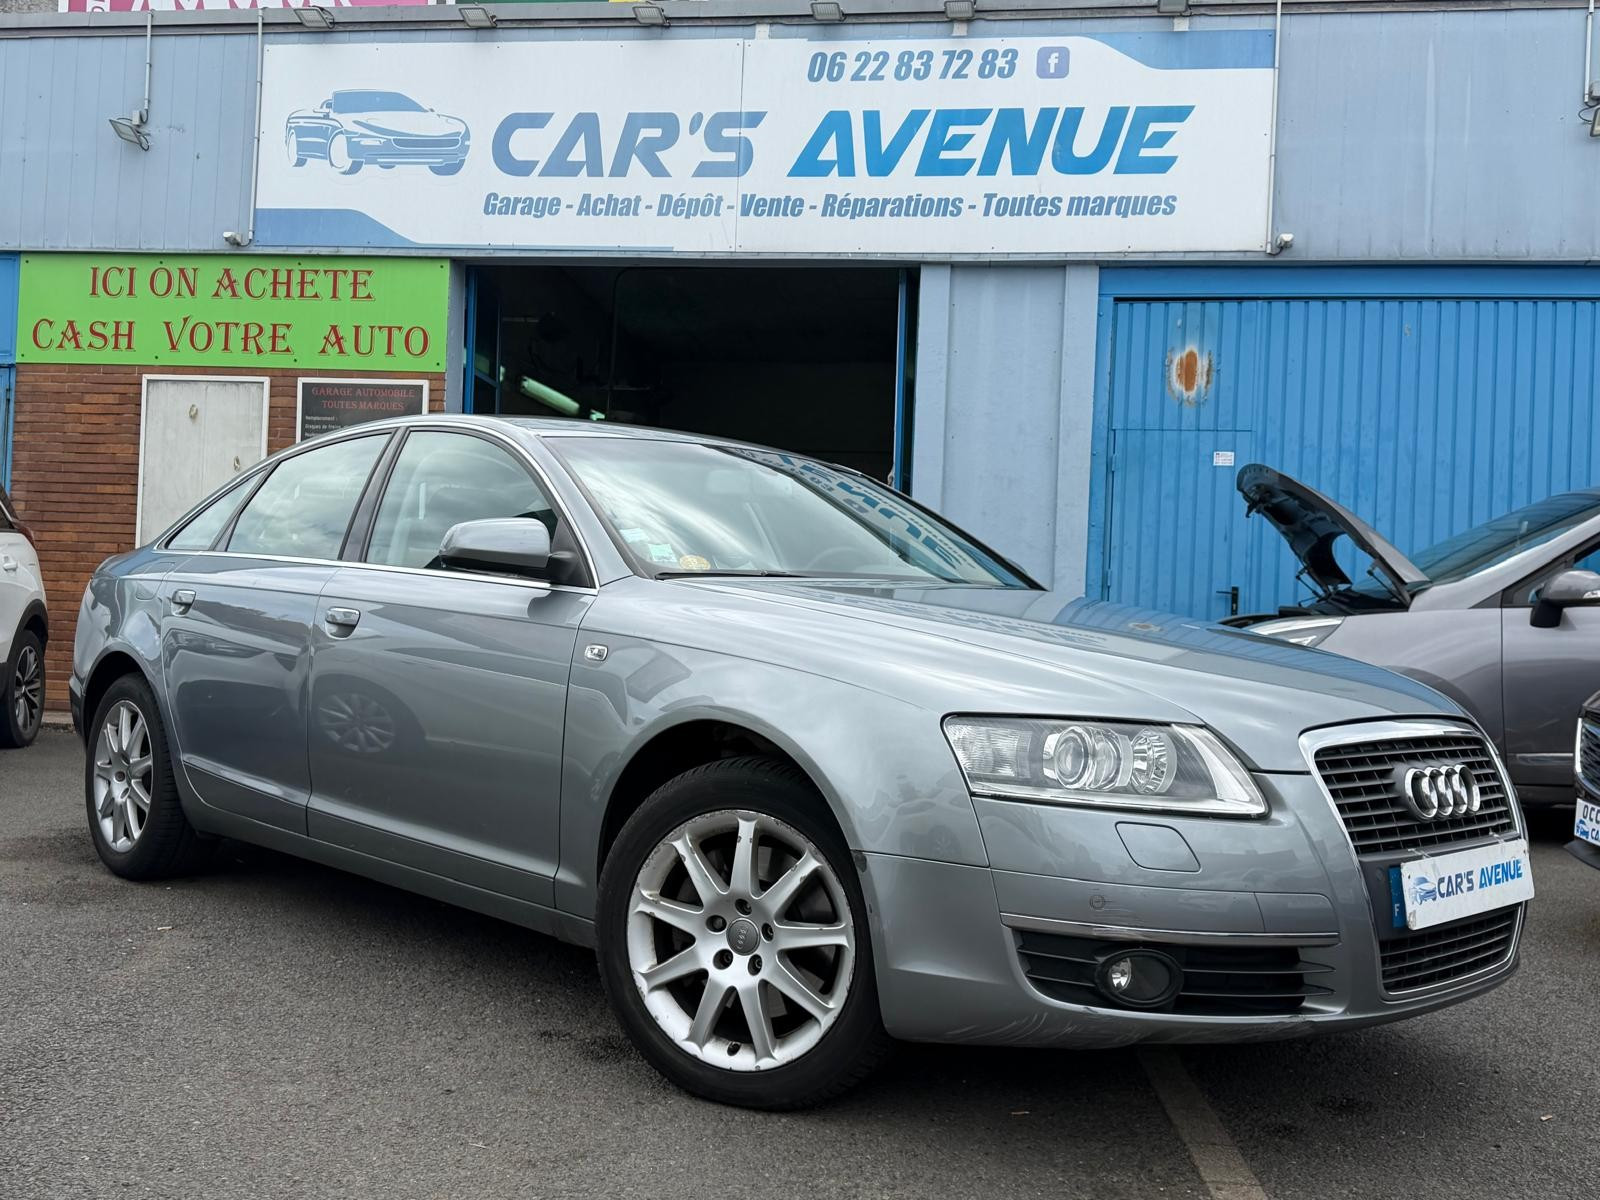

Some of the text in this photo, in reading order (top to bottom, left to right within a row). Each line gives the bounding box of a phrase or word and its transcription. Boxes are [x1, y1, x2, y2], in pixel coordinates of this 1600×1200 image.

[807, 51, 847, 82] 06
[850, 51, 890, 82] 22
[894, 50, 934, 81] 83
[938, 49, 974, 80] 72
[978, 48, 1018, 79] 83
[492, 105, 1196, 177] CAR'S AVENUE
[483, 192, 562, 219] Garage
[576, 192, 642, 217] Achat
[657, 193, 723, 219] Dépôt
[739, 193, 804, 217] Vente
[821, 192, 963, 220] Réparations
[982, 192, 1061, 217] Toutes
[1066, 195, 1178, 219] marques
[89, 266, 376, 301] ICI ON ACHETE
[32, 315, 431, 357] CASH VOTRE AUTO
[312, 387, 415, 397] GARAGE AUTOMOBILE
[321, 400, 404, 410] TOUTES MARQUES
[1437, 859, 1523, 898] CAR'S AVENUE
